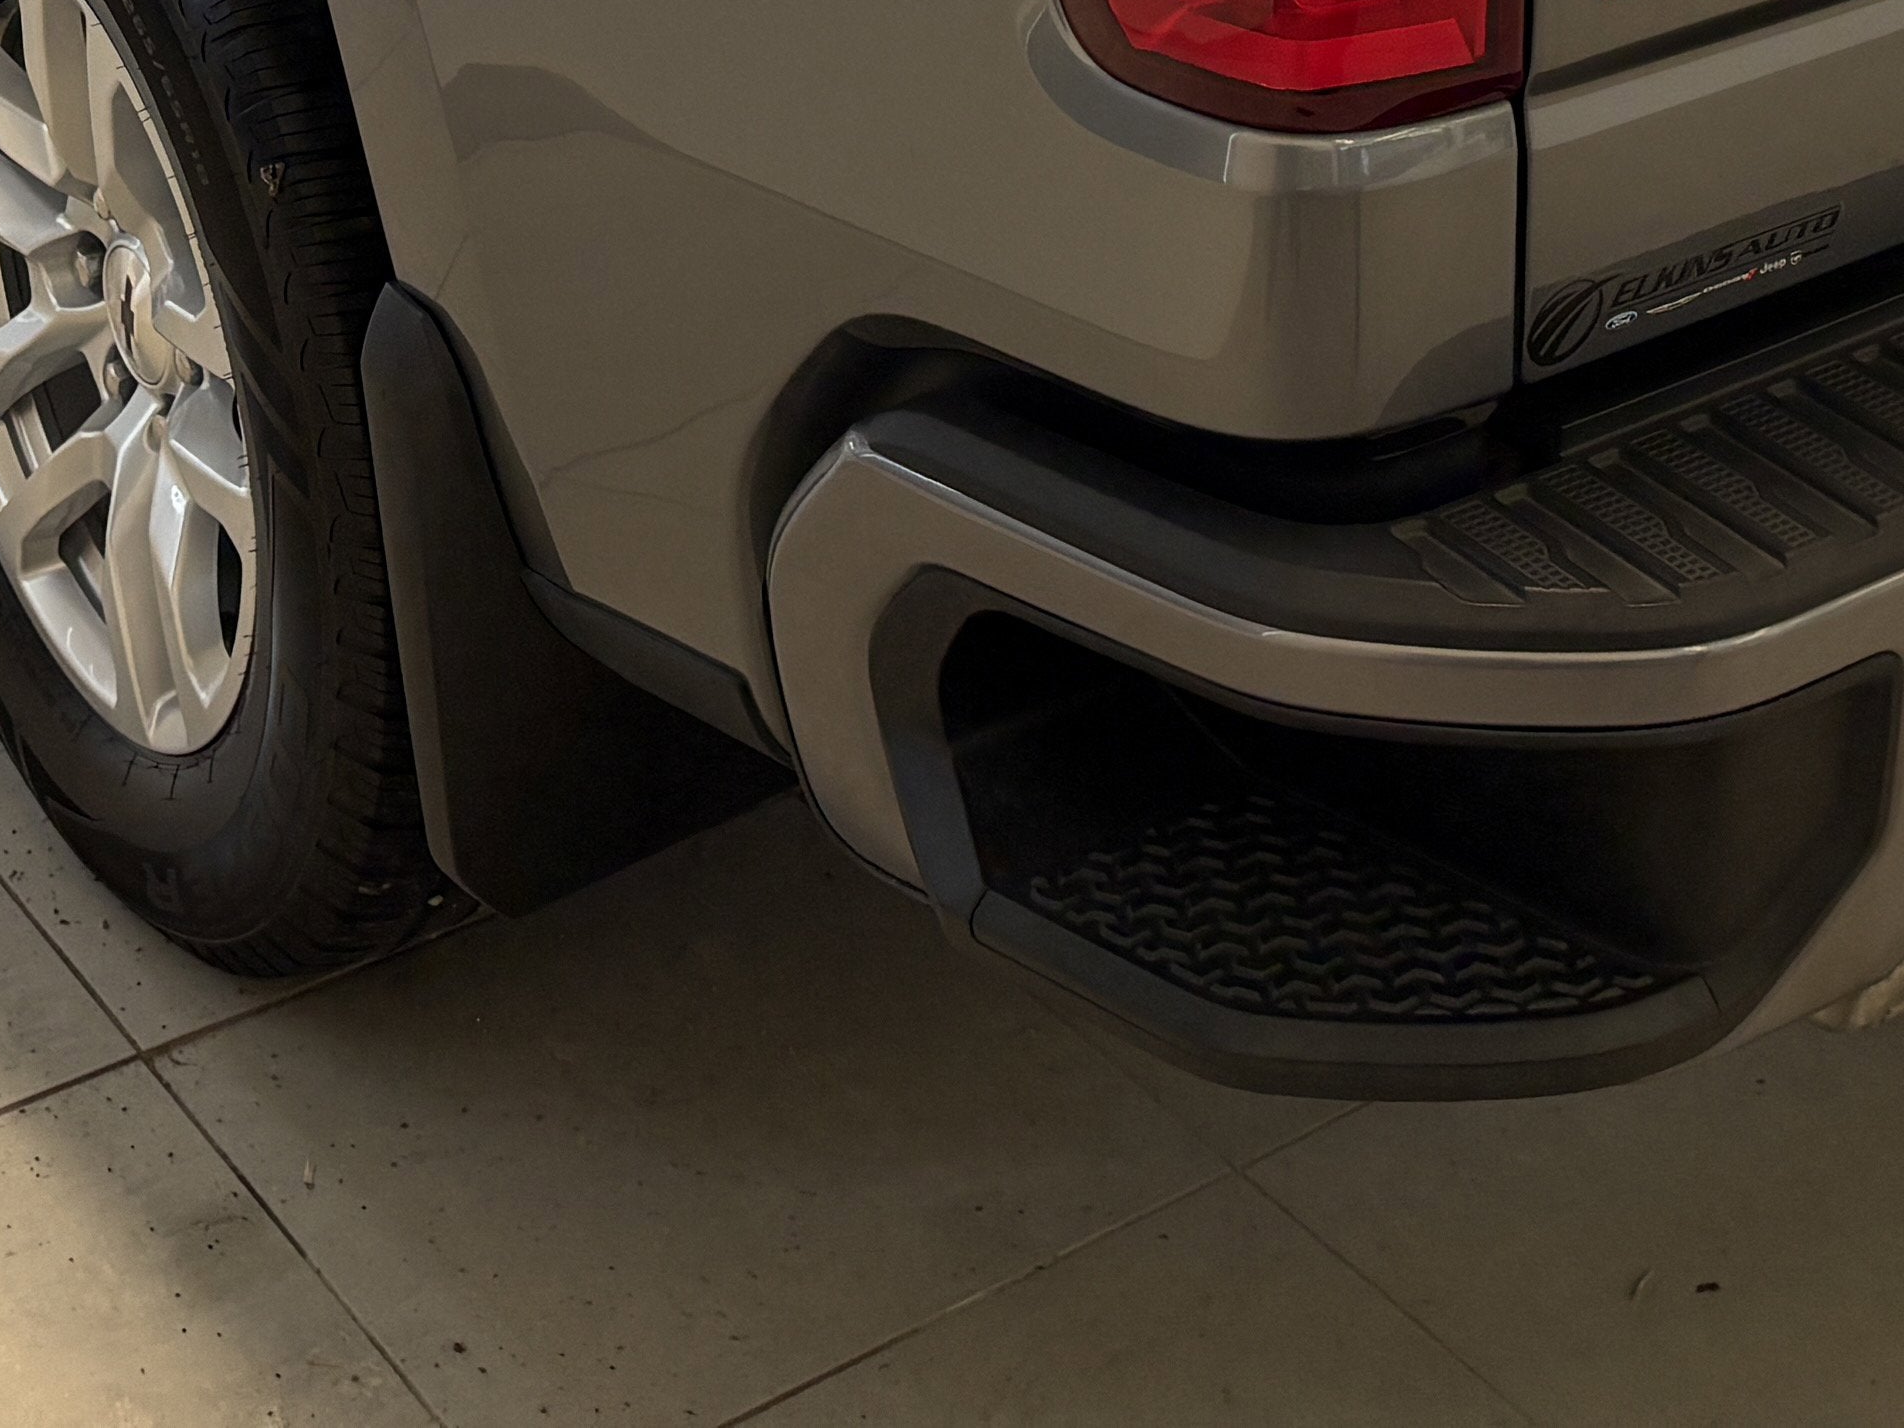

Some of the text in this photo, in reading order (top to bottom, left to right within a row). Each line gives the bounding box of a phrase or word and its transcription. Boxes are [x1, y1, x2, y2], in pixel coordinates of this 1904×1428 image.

[1614, 210, 1841, 304] ELKINS AUTO
[1759, 257, 1788, 276] Jeep
